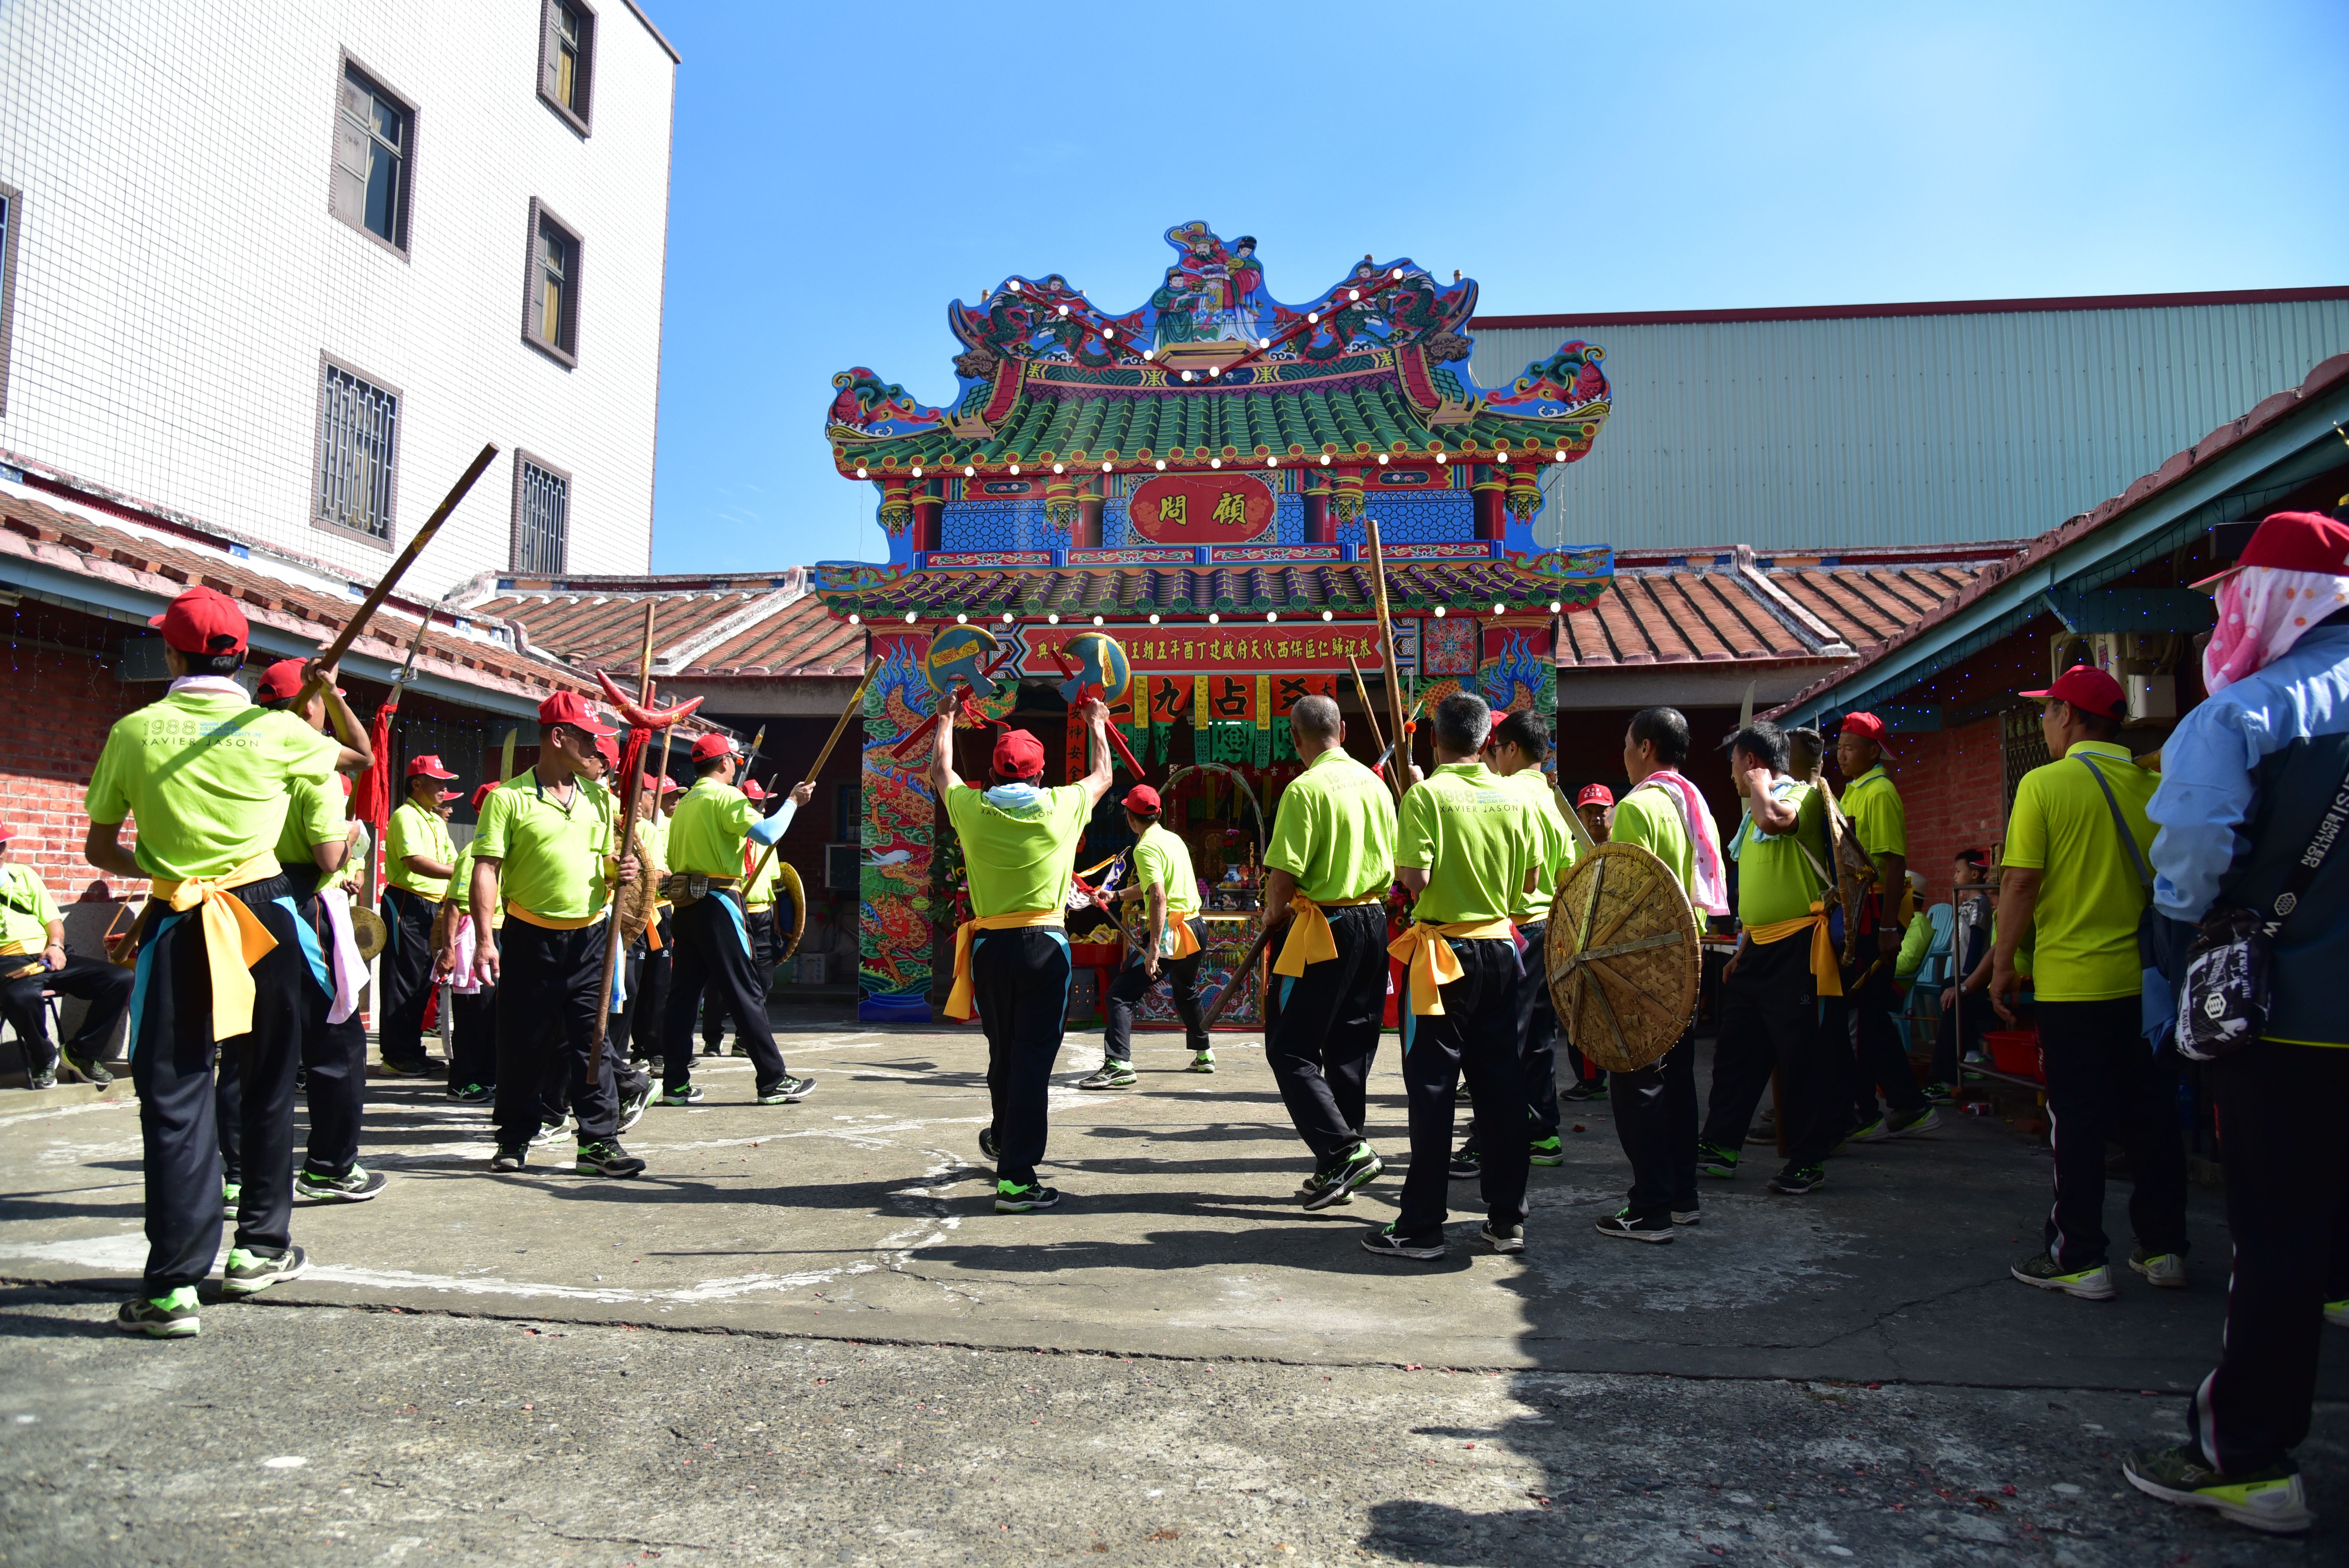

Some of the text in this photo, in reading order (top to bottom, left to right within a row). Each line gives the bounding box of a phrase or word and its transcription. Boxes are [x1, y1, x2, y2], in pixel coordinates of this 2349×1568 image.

[143, 719, 196, 736] 1988
[141, 738, 258, 747] XAVIER JASON
[1436, 789, 1474, 804] 1988
[1440, 804, 1518, 813] XAVIER JASON
[2300, 813, 2338, 865] EDITION
[2309, 815, 2345, 868] LIMITED
